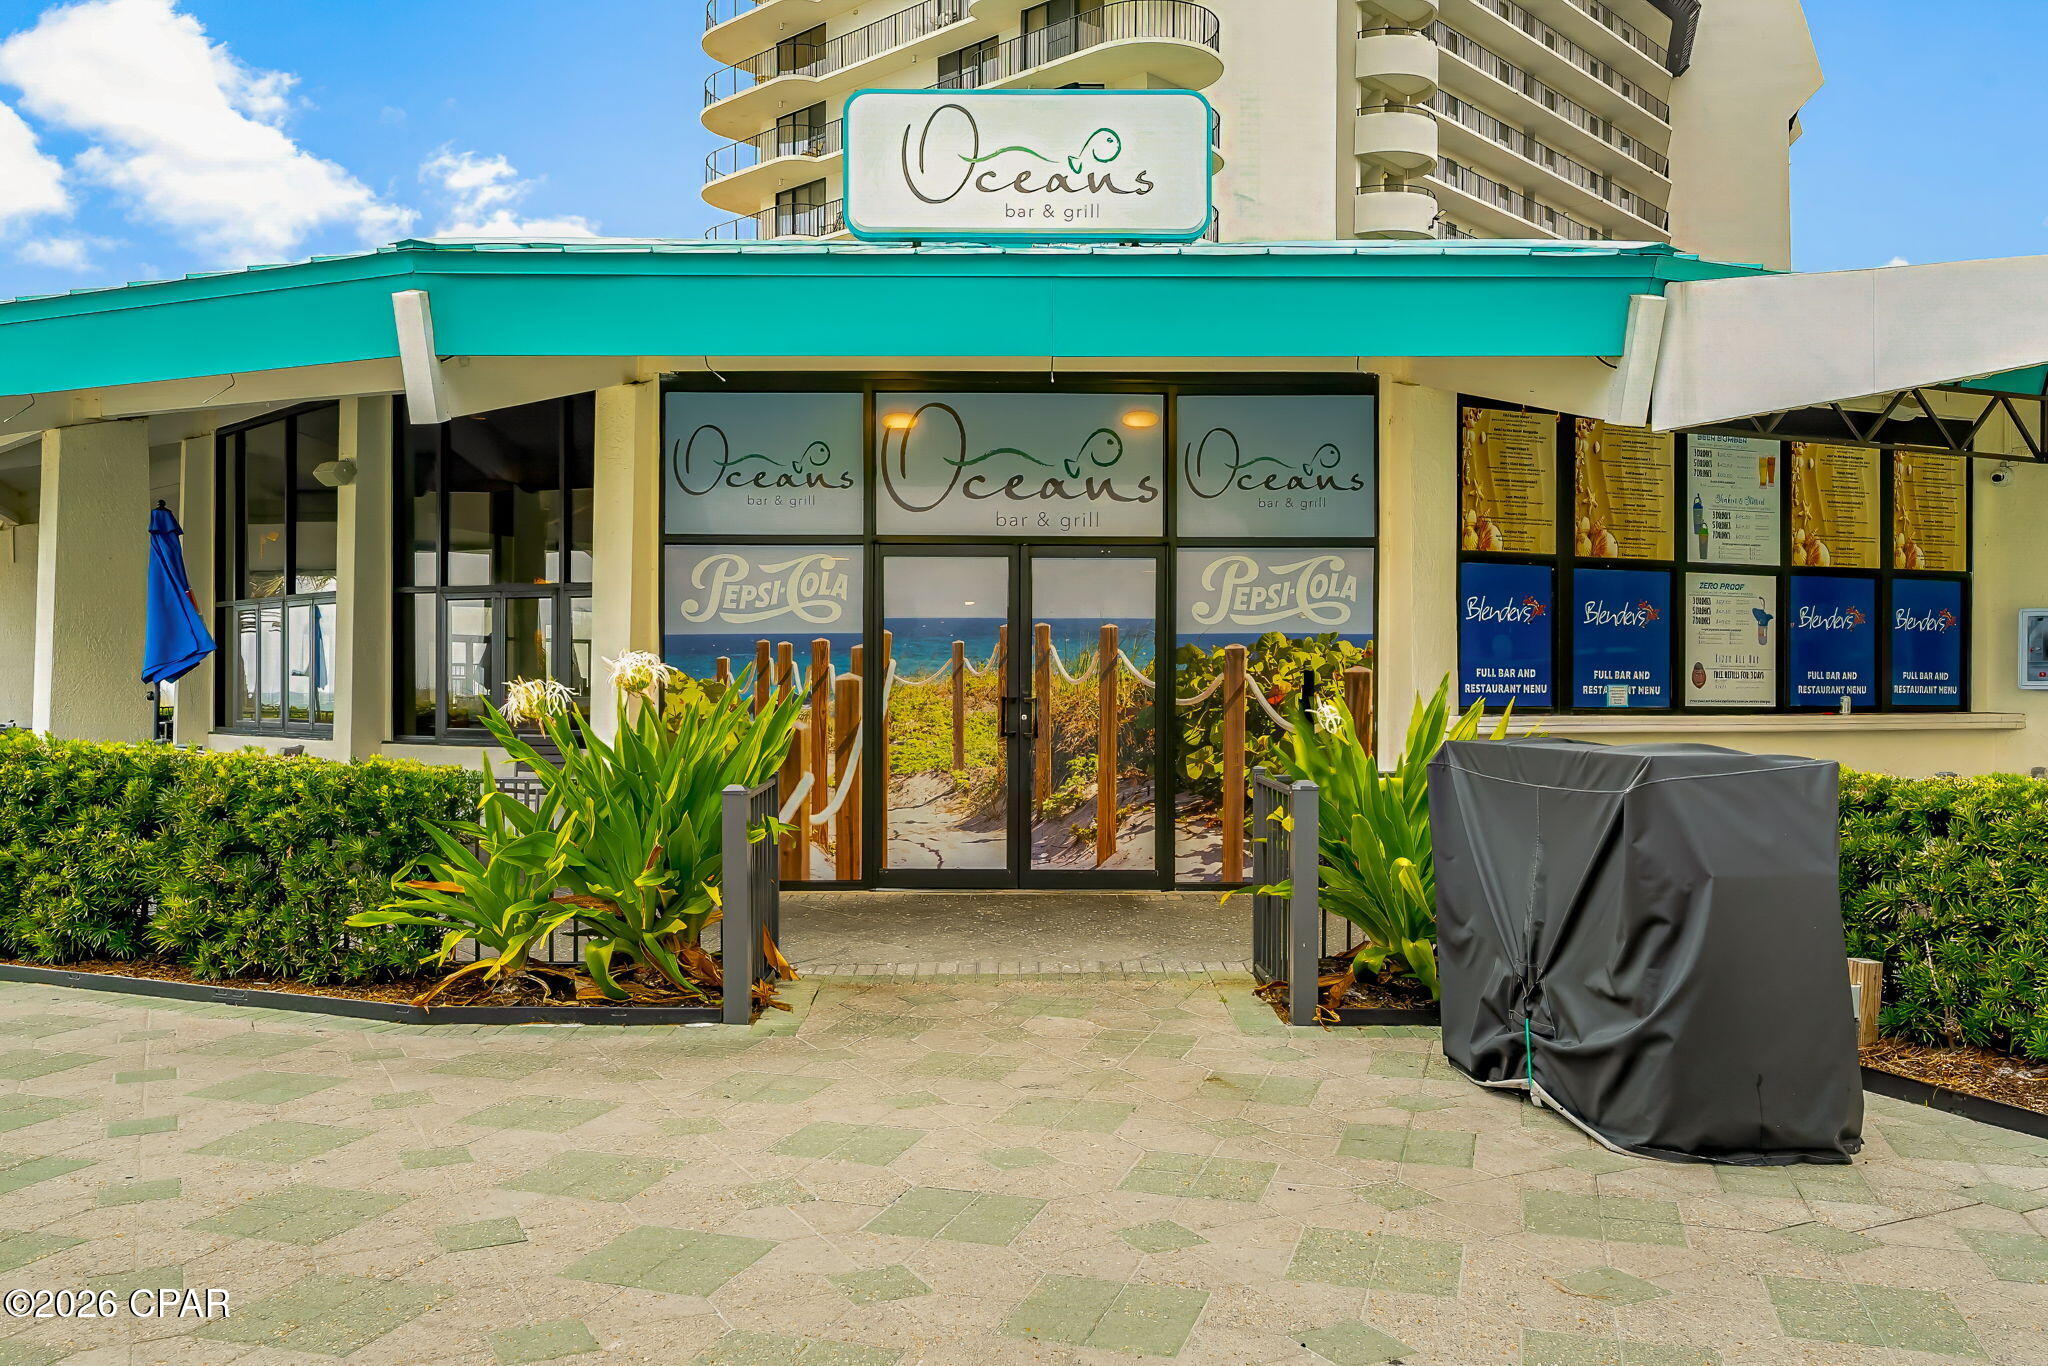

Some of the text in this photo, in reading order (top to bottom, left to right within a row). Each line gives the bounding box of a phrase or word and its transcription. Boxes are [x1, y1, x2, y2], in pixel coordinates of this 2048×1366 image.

[902, 103, 1157, 204] Oceans
[1005, 203, 1100, 222] bar & grill
[673, 424, 854, 496] Oceans
[881, 402, 1159, 513] Oceans
[1185, 427, 1365, 499] Oceans
[747, 495, 815, 508] bar & grill
[1258, 498, 1326, 511] bar & grill
[996, 511, 1100, 532] bar & grill
[1699, 582, 1718, 590] ZERO
[1465, 595, 1532, 624] Blenders
[1583, 600, 1646, 627] Blenders
[1798, 605, 1854, 631] Blenders
[1894, 607, 1946, 633] Blenders
[1476, 668, 1536, 678] FULL BAR AND
[1593, 670, 1650, 680] FULL BAR AND
[1807, 671, 1858, 680] FULL BAR AND
[1902, 671, 1949, 681] FULL BAR AND
[1464, 684, 1547, 694] RESTAURANT MENU
[1582, 685, 1661, 695] RESTANT MENU
[1798, 685, 1867, 694] RESTAURANT MENU
[1893, 685, 1958, 694] RESTAURANT MENU
